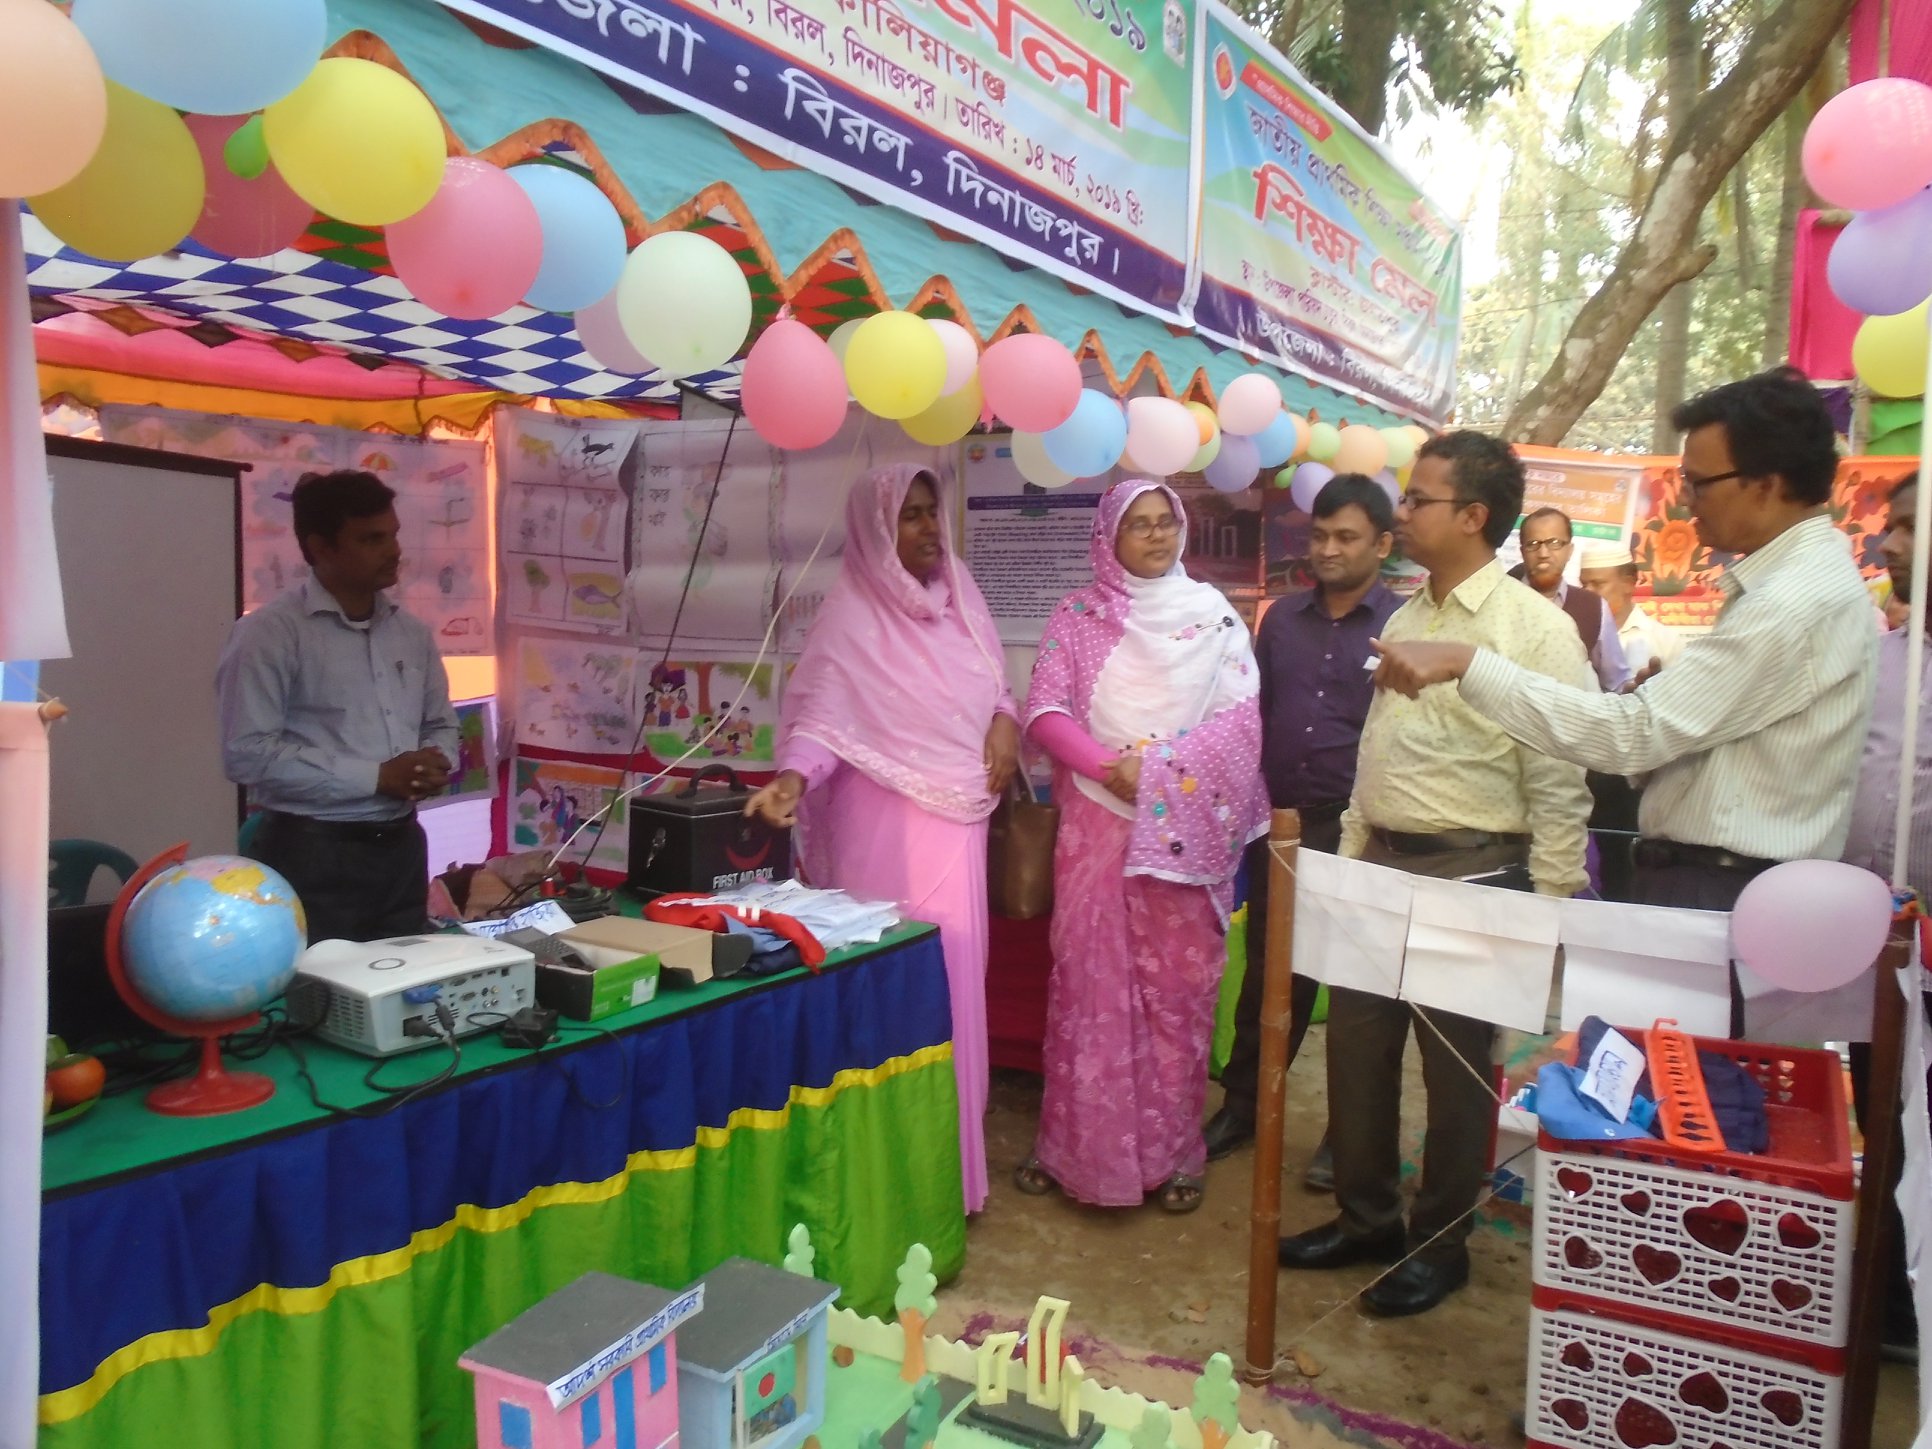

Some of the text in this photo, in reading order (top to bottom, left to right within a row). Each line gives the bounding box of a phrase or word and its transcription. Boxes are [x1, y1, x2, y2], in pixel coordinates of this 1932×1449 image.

[1076, 0, 1146, 50] ০১৯
[777, 67, 924, 188] বিরল,
[955, 97, 1007, 149] তারিখ
[1024, 138, 1045, 170] ১৪
[1086, 173, 1122, 214] ২০১৯
[1252, 161, 1361, 277] শিক্ষা
[713, 867, 774, 889] FIRST AID BOX
